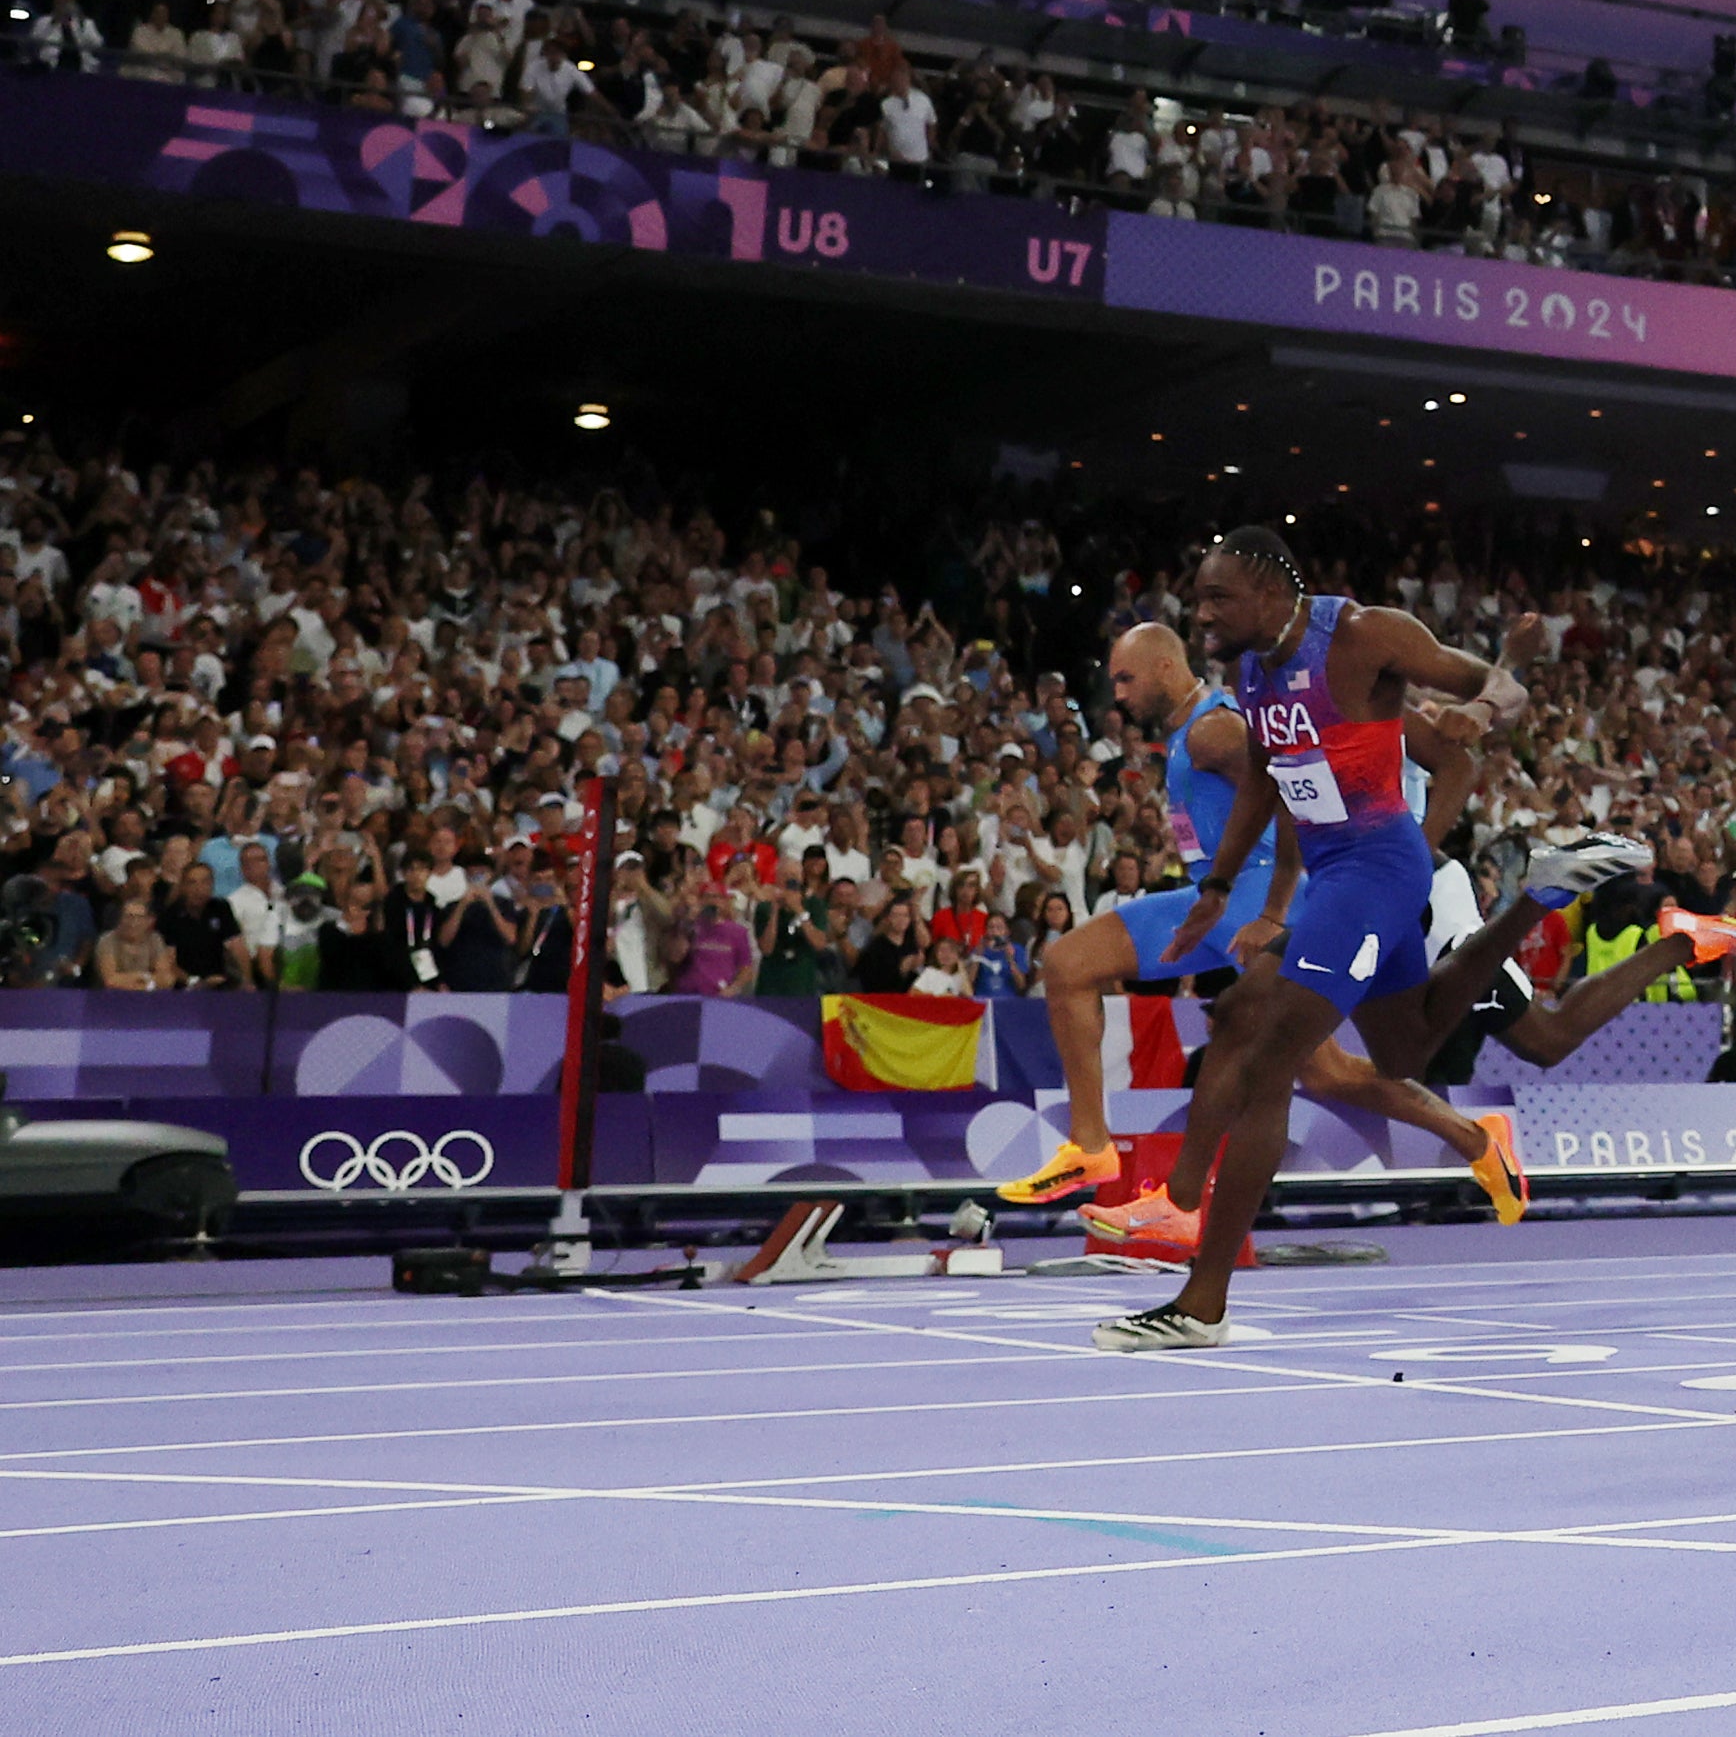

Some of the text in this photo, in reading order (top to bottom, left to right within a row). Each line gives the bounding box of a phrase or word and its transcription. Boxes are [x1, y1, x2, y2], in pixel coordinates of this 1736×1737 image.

[777, 206, 849, 258] U8
[1027, 237, 1092, 286] U7
[1314, 264, 1647, 342] PARIS 2024
[1245, 702, 1320, 748] USA
[1555, 1129, 1706, 1166] PARIS
